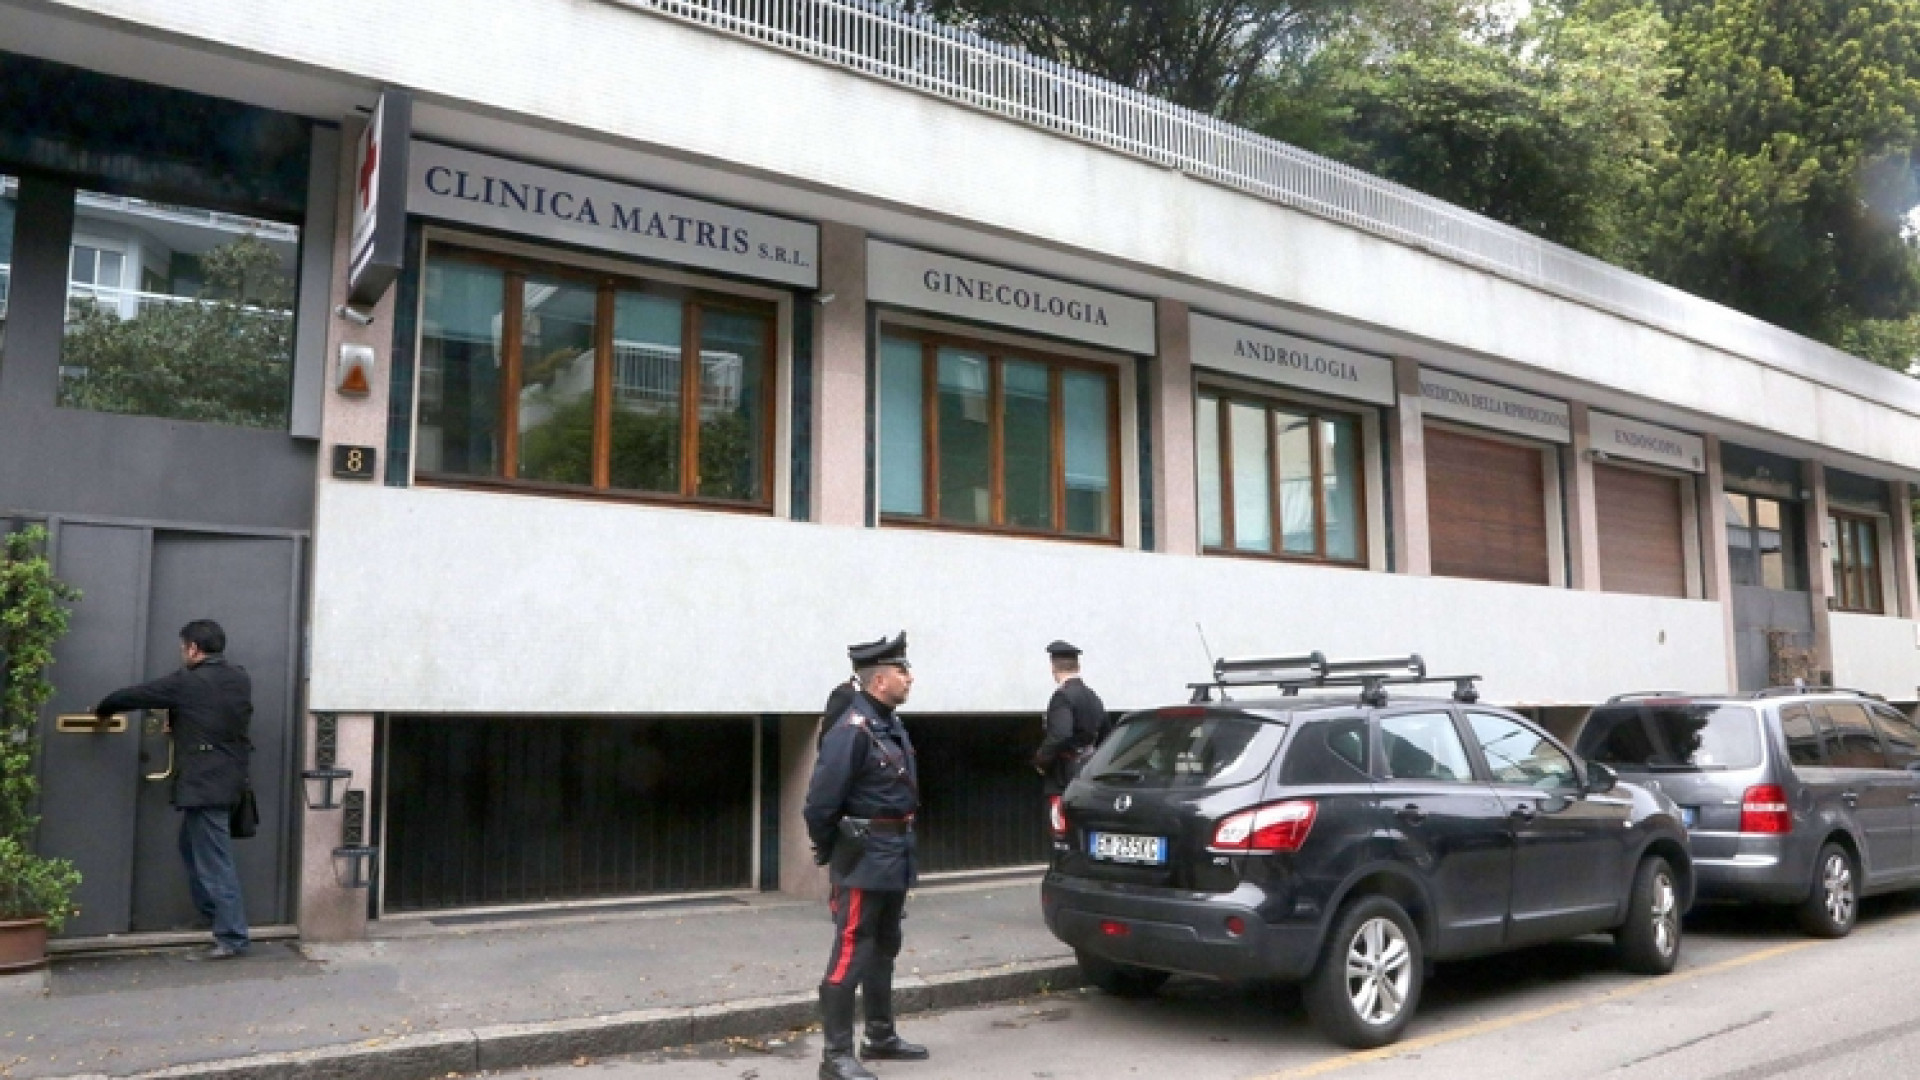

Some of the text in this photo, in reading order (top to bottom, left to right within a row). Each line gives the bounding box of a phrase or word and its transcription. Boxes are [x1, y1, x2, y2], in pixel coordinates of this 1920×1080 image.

[424, 165, 810, 268] CLINICA MATRIS S.R.L.
[923, 268, 1109, 326] GINECOLOGIA
[1234, 338, 1359, 383] ANDROLOGIA
[1472, 393, 1502, 413] DELLA
[347, 449, 362, 471] 8
[1614, 429, 1683, 457] ENDOSCOPIA
